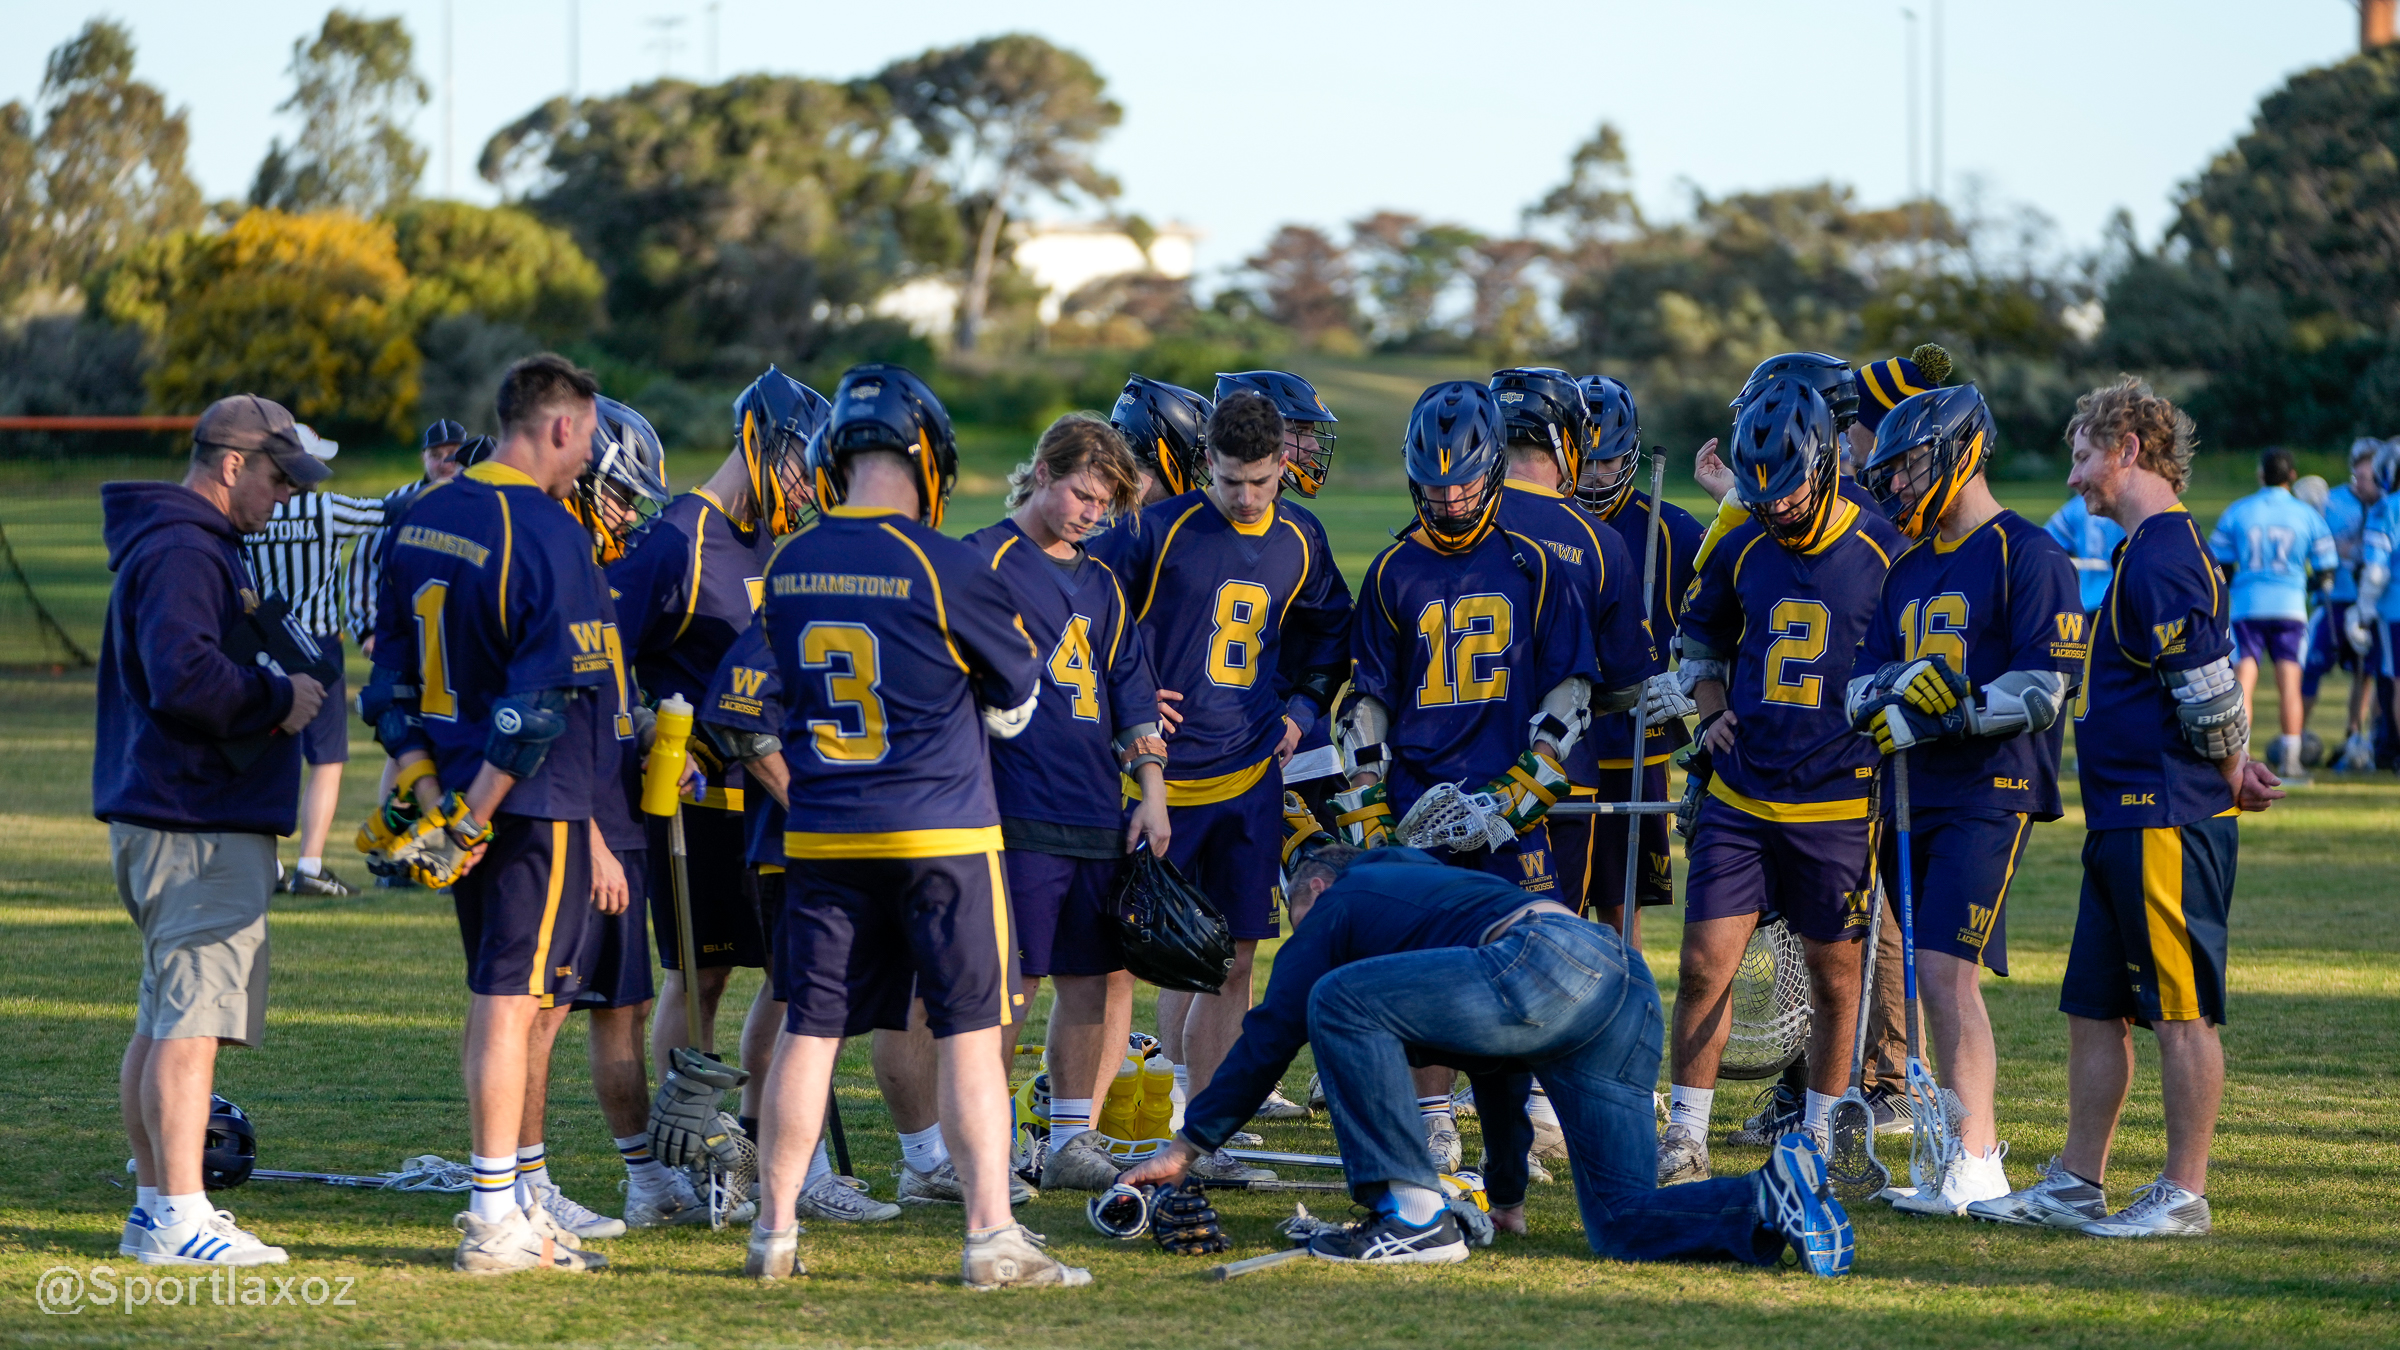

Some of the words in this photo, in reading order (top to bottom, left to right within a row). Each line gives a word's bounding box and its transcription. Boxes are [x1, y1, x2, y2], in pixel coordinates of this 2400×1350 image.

[2247, 525, 2297, 576] 17
[772, 572, 912, 599] WILLIAMSTOWN
[1205, 579, 1272, 690] 8
[1898, 591, 1970, 676] 16
[2054, 611, 2085, 642] W
[411, 578, 459, 723] 1
[1417, 592, 1513, 709] 12
[1761, 597, 1831, 709] 2
[2050, 648, 2087, 659] LACROSSE
[731, 666, 768, 698] W
[1046, 613, 1101, 724] 4
[718, 700, 762, 717] LACROSSE
[798, 620, 891, 765] 3
[2197, 691, 2244, 725] BRIN
[1644, 726, 1666, 738] BLK
[1993, 777, 2030, 790] BLK
[2121, 793, 2156, 806] BLK
[1517, 849, 1546, 879] W
[1843, 917, 1871, 929] LACROSS
[1967, 901, 1993, 933] W
[703, 943, 735, 953] BLK
